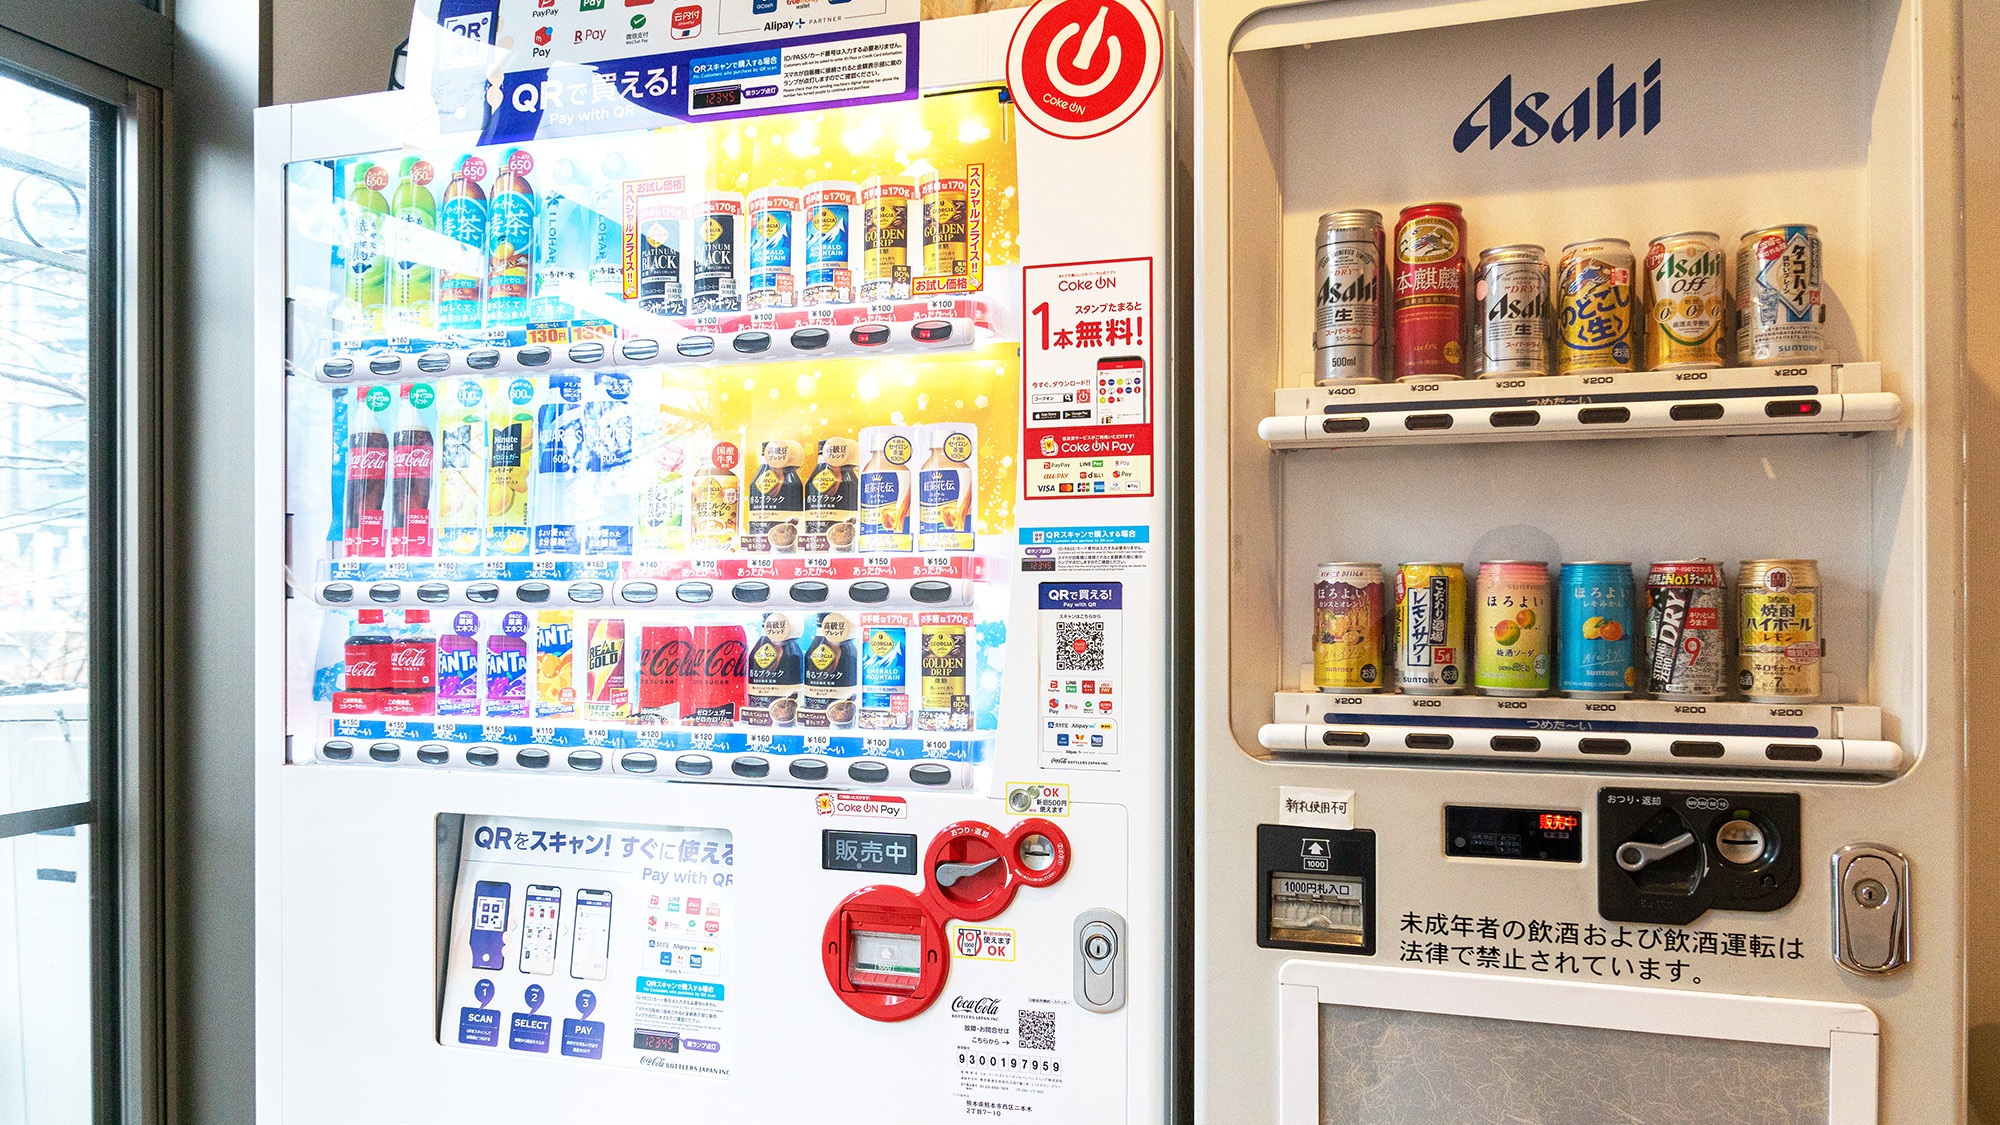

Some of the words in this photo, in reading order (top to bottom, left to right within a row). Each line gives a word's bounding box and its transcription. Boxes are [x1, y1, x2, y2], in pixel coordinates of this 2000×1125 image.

[532, 8, 559, 18] PayPay
[763, 18, 794, 31] Alipay
[808, 15, 842, 25] PARTNER
[585, 28, 607, 41] Pay
[532, 47, 551, 58] Pay
[693, 56, 778, 73] QRスキャンで購入する場合
[705, 91, 736, 106] 12345
[1042, 93, 1068, 109] Coke
[1453, 58, 1661, 153] Asahi
[550, 109, 577, 127] Pay
[579, 106, 610, 122] with
[614, 102, 635, 118] QR
[463, 165, 485, 177] 650
[510, 160, 532, 172] 650
[970, 167, 980, 274] スペシャルプライス!!
[642, 256, 677, 272] BLACK
[1656, 252, 1720, 281] Asahi
[1397, 267, 1460, 294] 本麒麟
[1792, 245, 1806, 305] タコハイ
[915, 278, 967, 291] お試し価格
[1058, 279, 1093, 291] Coke
[1095, 276, 1116, 289] ON
[1672, 277, 1710, 293] Off
[1316, 274, 1377, 308] Asahi
[1075, 301, 1142, 314] スタンプたまると
[1561, 286, 1630, 328] のどごし
[1335, 309, 1353, 322] 生
[1032, 301, 1143, 350] 1本無料!
[1515, 324, 1532, 335] 生
[529, 329, 567, 344] 130円
[1325, 328, 1364, 336] スーパードライ
[1331, 357, 1356, 367] 500ml
[1328, 388, 1356, 396] ¥400
[1411, 384, 1439, 392] ¥300
[494, 435, 518, 444] Minute
[948, 440, 969, 448] セイロン
[494, 443, 514, 451] Maid
[717, 447, 735, 455] 国産
[1061, 442, 1090, 452] Coke
[1092, 440, 1109, 452] ON
[1111, 442, 1135, 453] Pay
[717, 456, 735, 464] 牛乳
[1030, 562, 1051, 570] 12345
[1048, 589, 1112, 601] QRで買える!
[1318, 588, 1366, 600] ほろよい
[1574, 587, 1630, 598] ほろよい
[1487, 596, 1544, 608] ほろよい
[1431, 580, 1446, 643] こだわり酒場
[1761, 604, 1796, 618] 焼酎
[1661, 591, 1687, 646] DRY
[766, 620, 786, 630] 高級豆
[823, 621, 845, 631] 高級豆
[1412, 591, 1428, 663] レモンサワー
[1746, 618, 1812, 632] ハイボール
[1763, 633, 1793, 641] レモン
[589, 641, 619, 657] REAL
[1497, 649, 1534, 657] 梅酒ソーダ
[589, 653, 619, 670] GOLD
[922, 657, 964, 669] GOLDEN
[1652, 642, 1666, 681] STRONG
[930, 668, 953, 676] DRIP
[1361, 669, 1376, 679] お酒
[1660, 656, 1675, 684] ZERO
[1755, 664, 1801, 673] 辛口チューハイ
[1403, 676, 1439, 684] SUNTORY
[1442, 669, 1458, 681] お酒
[1335, 697, 1362, 705] ¥200
[1674, 706, 1706, 714] ¥200
[1770, 709, 1803, 717] ¥200
[694, 733, 712, 741] ¥120
[807, 736, 827, 744] ¥160
[927, 741, 947, 749] ¥100
[1043, 788, 1059, 797] OK
[1607, 794, 1661, 806] おつり・返却
[837, 803, 862, 812] Coke
[863, 803, 878, 813] ON
[880, 804, 900, 817] Pay
[1539, 814, 1578, 830] 販売中
[474, 826, 611, 857] QRをスキャン!
[836, 840, 907, 864] 販売中
[642, 868, 669, 884] Pay
[673, 870, 708, 885] with
[1284, 881, 1349, 895] 1000円札入口
[983, 936, 1011, 945] 使えます
[1400, 911, 1804, 960] 未成年者の飲酒および飲酒運転は
[988, 946, 1006, 957] OK
[1400, 939, 1701, 984] 法律で禁止されています。
[531, 993, 538, 1002] 2
[582, 999, 589, 1008] 3
[951, 996, 1001, 1015] Coca-Cola
[468, 1013, 493, 1024] SCAN
[514, 1018, 549, 1030] SELECT
[574, 1025, 593, 1035] PAY
[645, 1036, 674, 1050] 12345
[972, 1037, 1000, 1045] こちらから
